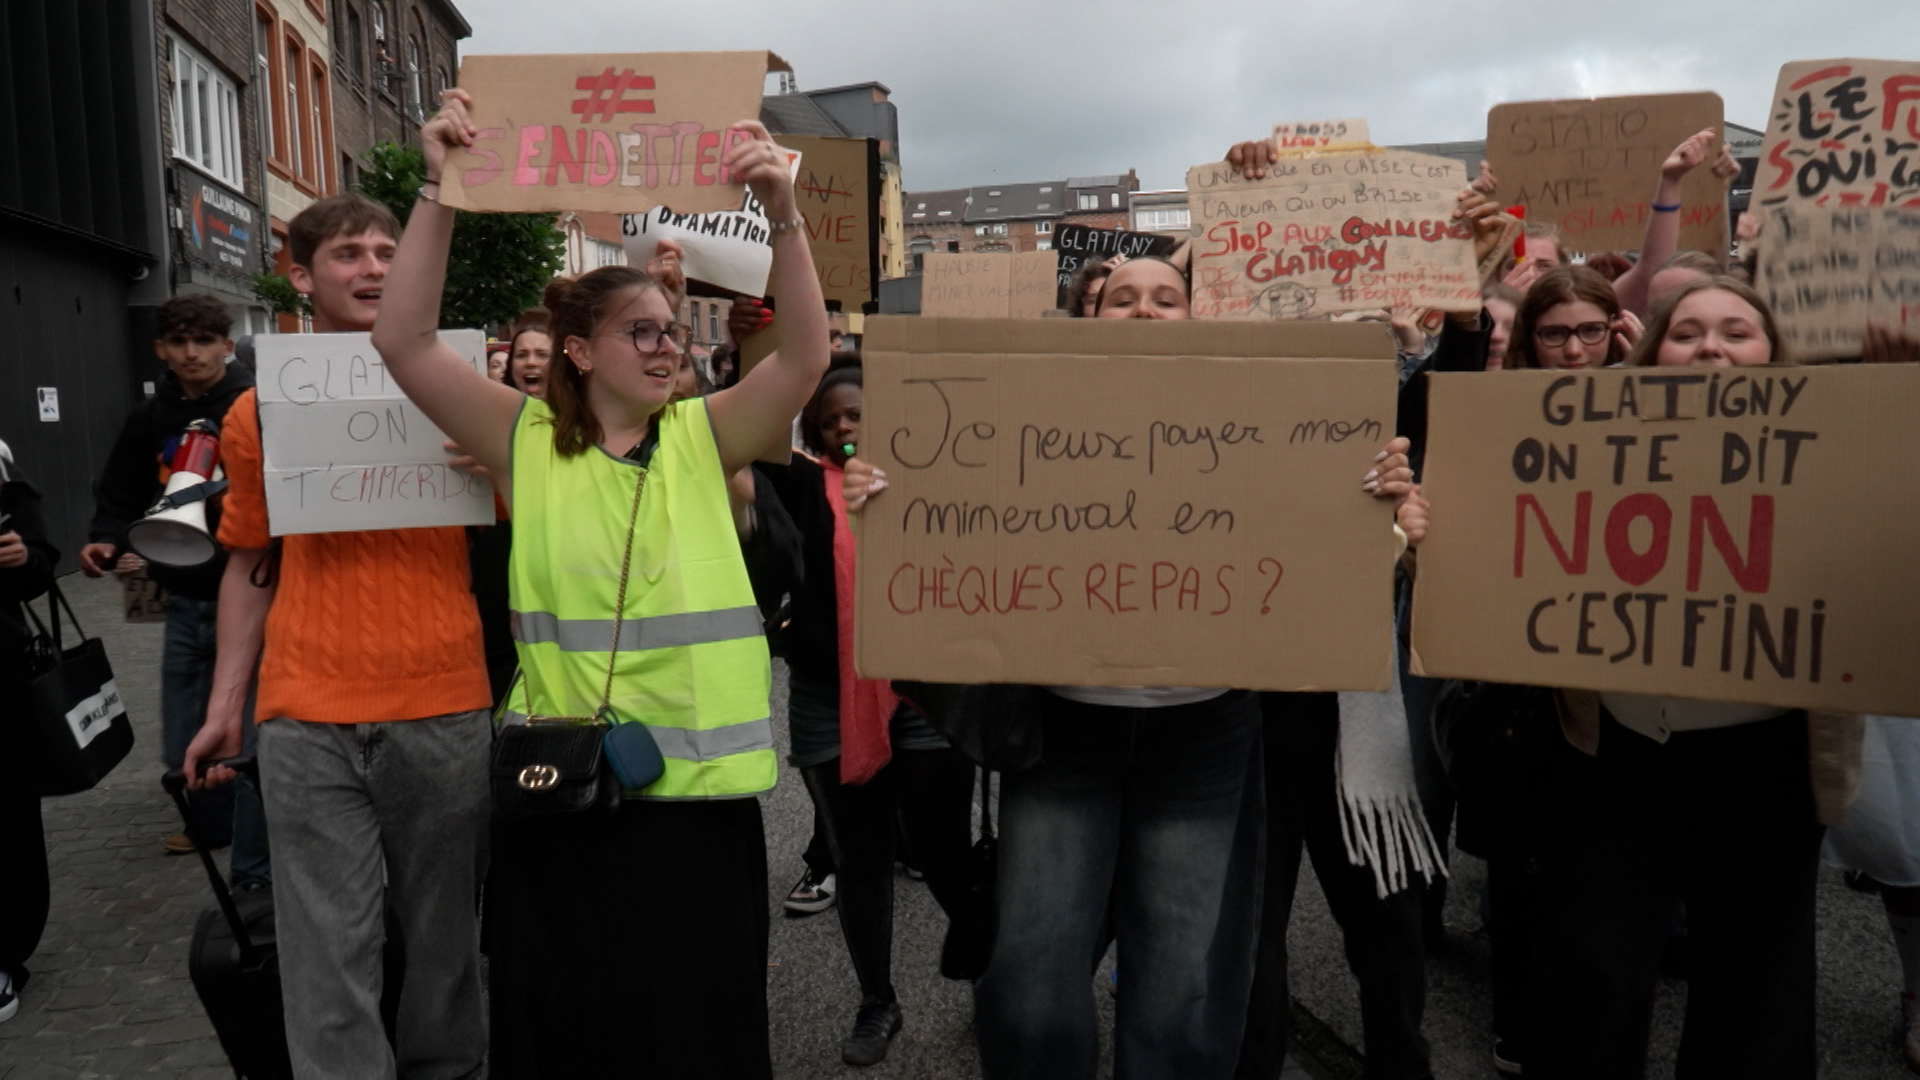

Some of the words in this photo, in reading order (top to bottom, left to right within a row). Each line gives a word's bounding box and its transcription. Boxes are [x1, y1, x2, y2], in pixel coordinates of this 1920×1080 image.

[1798, 76, 1877, 140] LE
[1060, 228, 1155, 256] GLATIGNY
[1199, 220, 1273, 258] STOP
[1282, 222, 1336, 246] AUX
[1246, 240, 1386, 285] GLATIGNY
[348, 404, 408, 445] ON
[891, 376, 996, 469] Je
[1017, 422, 1136, 487] peux
[1148, 419, 1265, 474] payer
[1288, 417, 1383, 445] mon
[1511, 435, 1578, 484] ON
[1604, 433, 1680, 485] TE
[902, 489, 1138, 538] minerval
[1167, 501, 1236, 534] en
[1513, 490, 1776, 595] NON
[887, 554, 1064, 617] CHÈQUES
[1085, 560, 1236, 616] REPAS
[1526, 591, 1668, 666] C'EST
